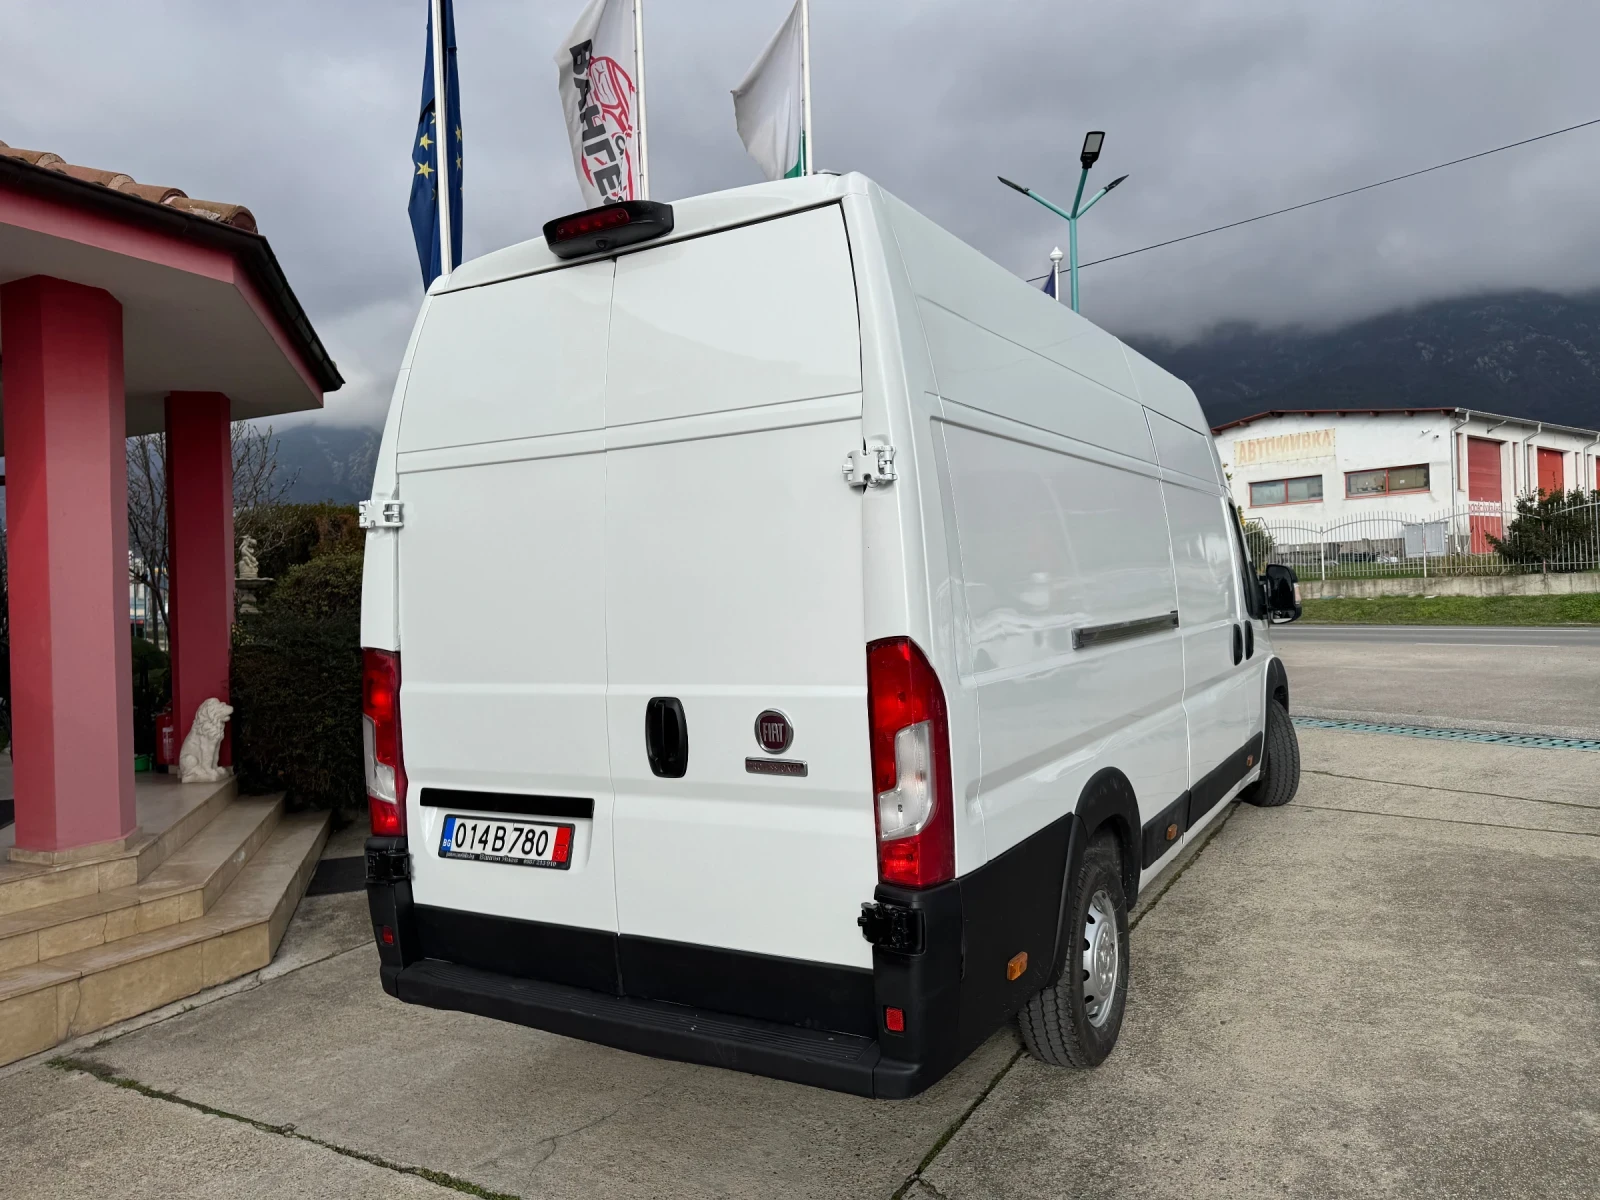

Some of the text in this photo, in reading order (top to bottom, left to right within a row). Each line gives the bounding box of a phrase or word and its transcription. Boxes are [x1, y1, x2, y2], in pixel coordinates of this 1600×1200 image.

[569, 39, 621, 205] ВАНГЕ
[1239, 431, 1332, 464] АВТОМИВКА
[762, 722, 784, 742] FIAT
[443, 823, 549, 857] BG 014B780
